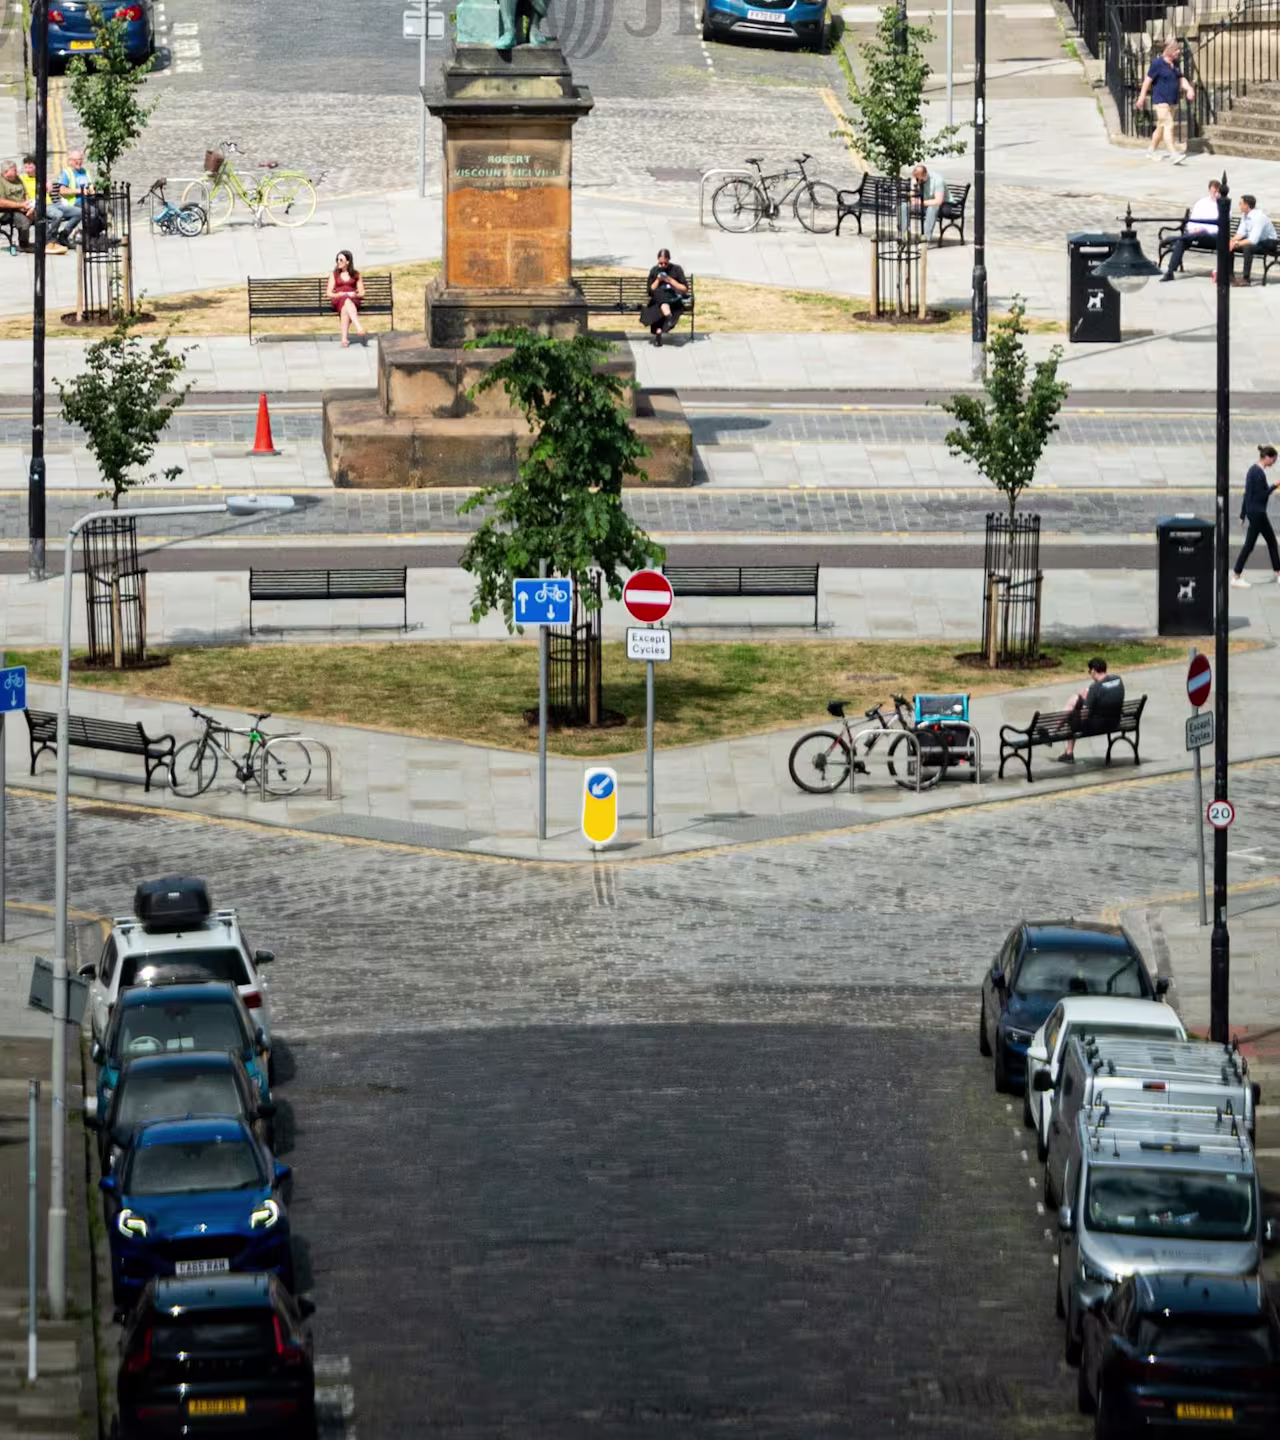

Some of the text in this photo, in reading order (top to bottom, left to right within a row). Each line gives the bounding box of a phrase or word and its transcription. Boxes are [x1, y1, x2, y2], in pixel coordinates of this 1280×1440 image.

[487, 154, 531, 164] ROBERT
[455, 168, 507, 177] VISCOUNT
[631, 632, 666, 644] Except
[632, 643, 666, 655] Cycles
[1189, 717, 1211, 733] Except
[1189, 731, 1211, 744] Cycles
[1211, 806, 1231, 820] 20
